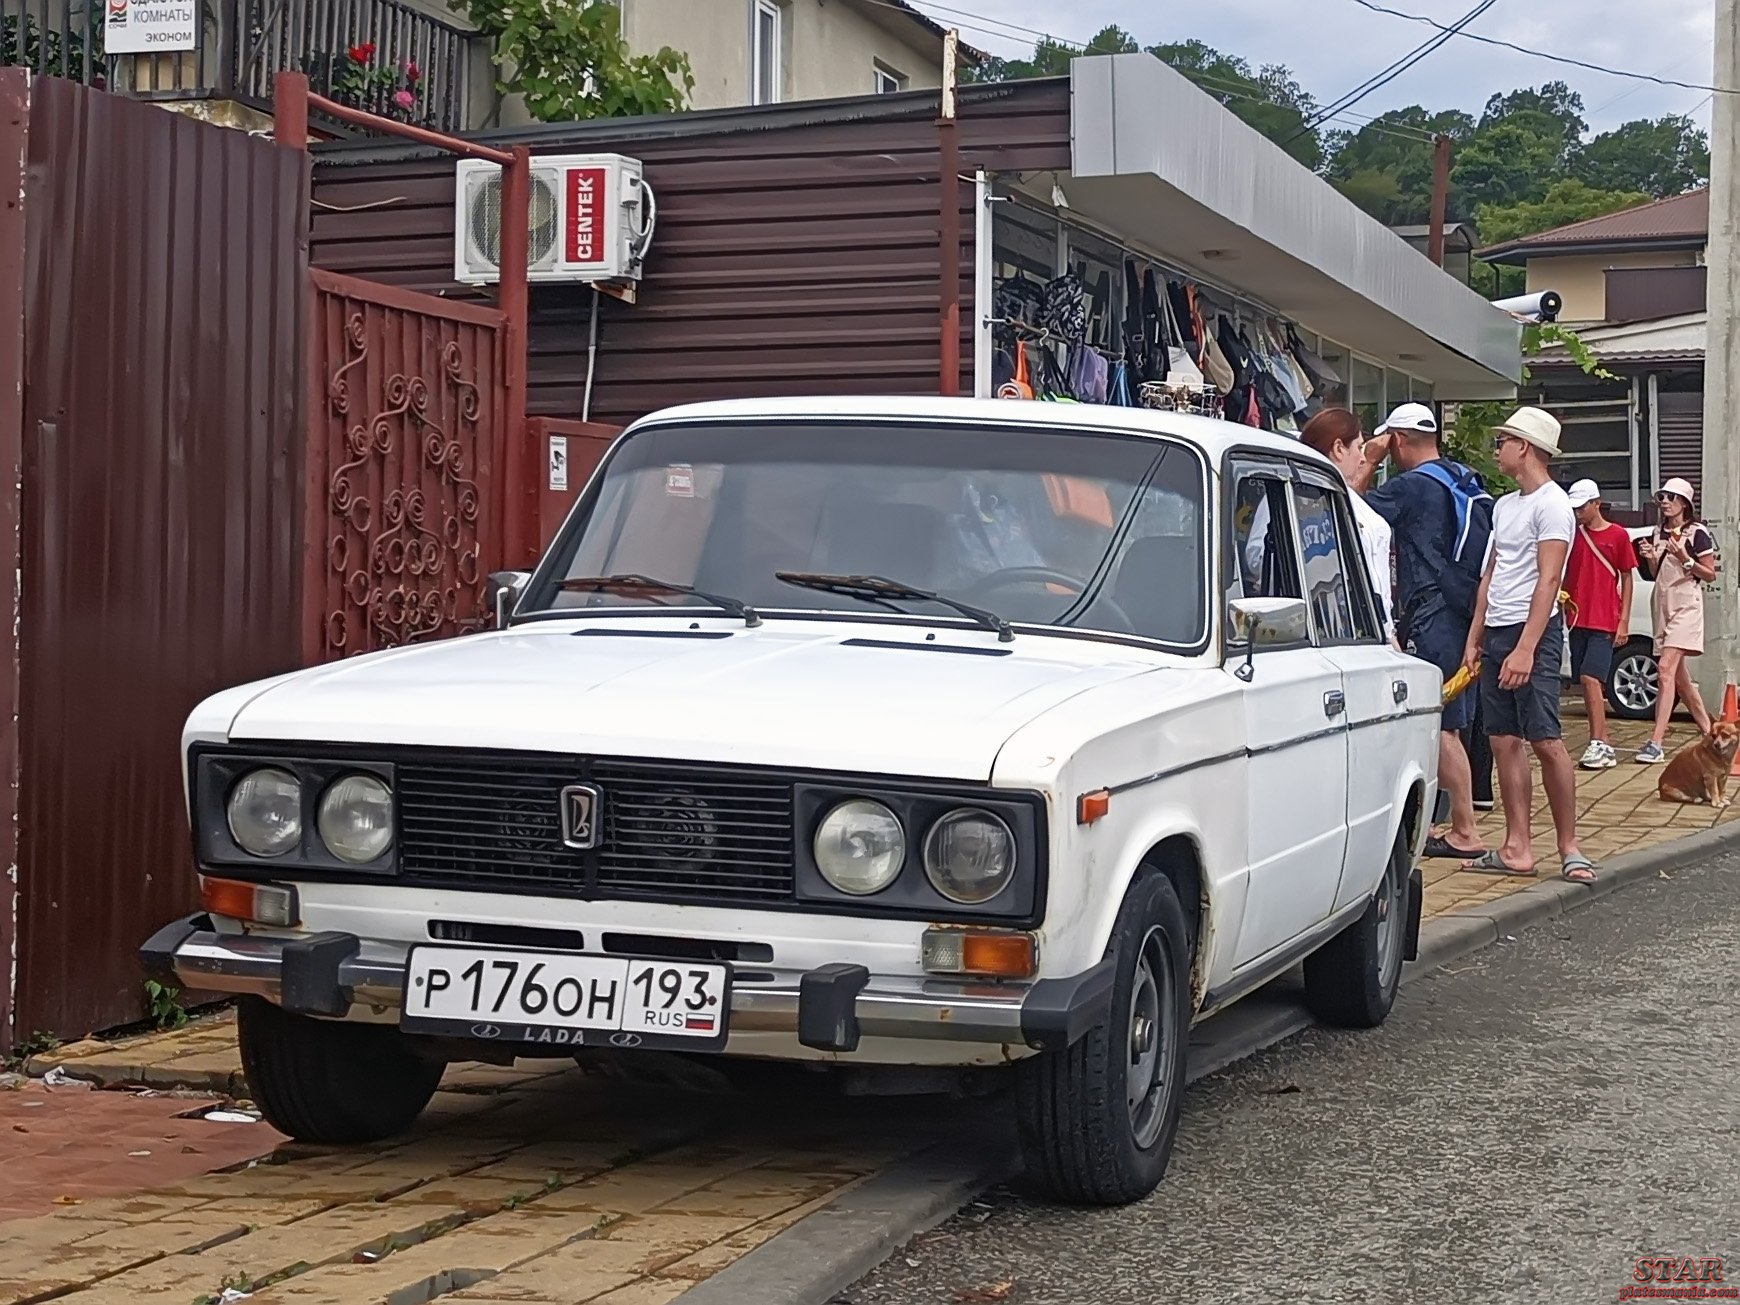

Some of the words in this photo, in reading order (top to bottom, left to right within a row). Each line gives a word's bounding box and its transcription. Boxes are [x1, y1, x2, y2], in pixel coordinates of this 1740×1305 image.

[133, 9, 192, 23] КОМНАТЫ
[145, 31, 192, 43] ЭКОНОМ
[577, 176, 594, 259] CENTEK
[633, 967, 711, 1011] 193
[644, 1010, 684, 1028] RUS
[523, 1026, 585, 1045] LADA
